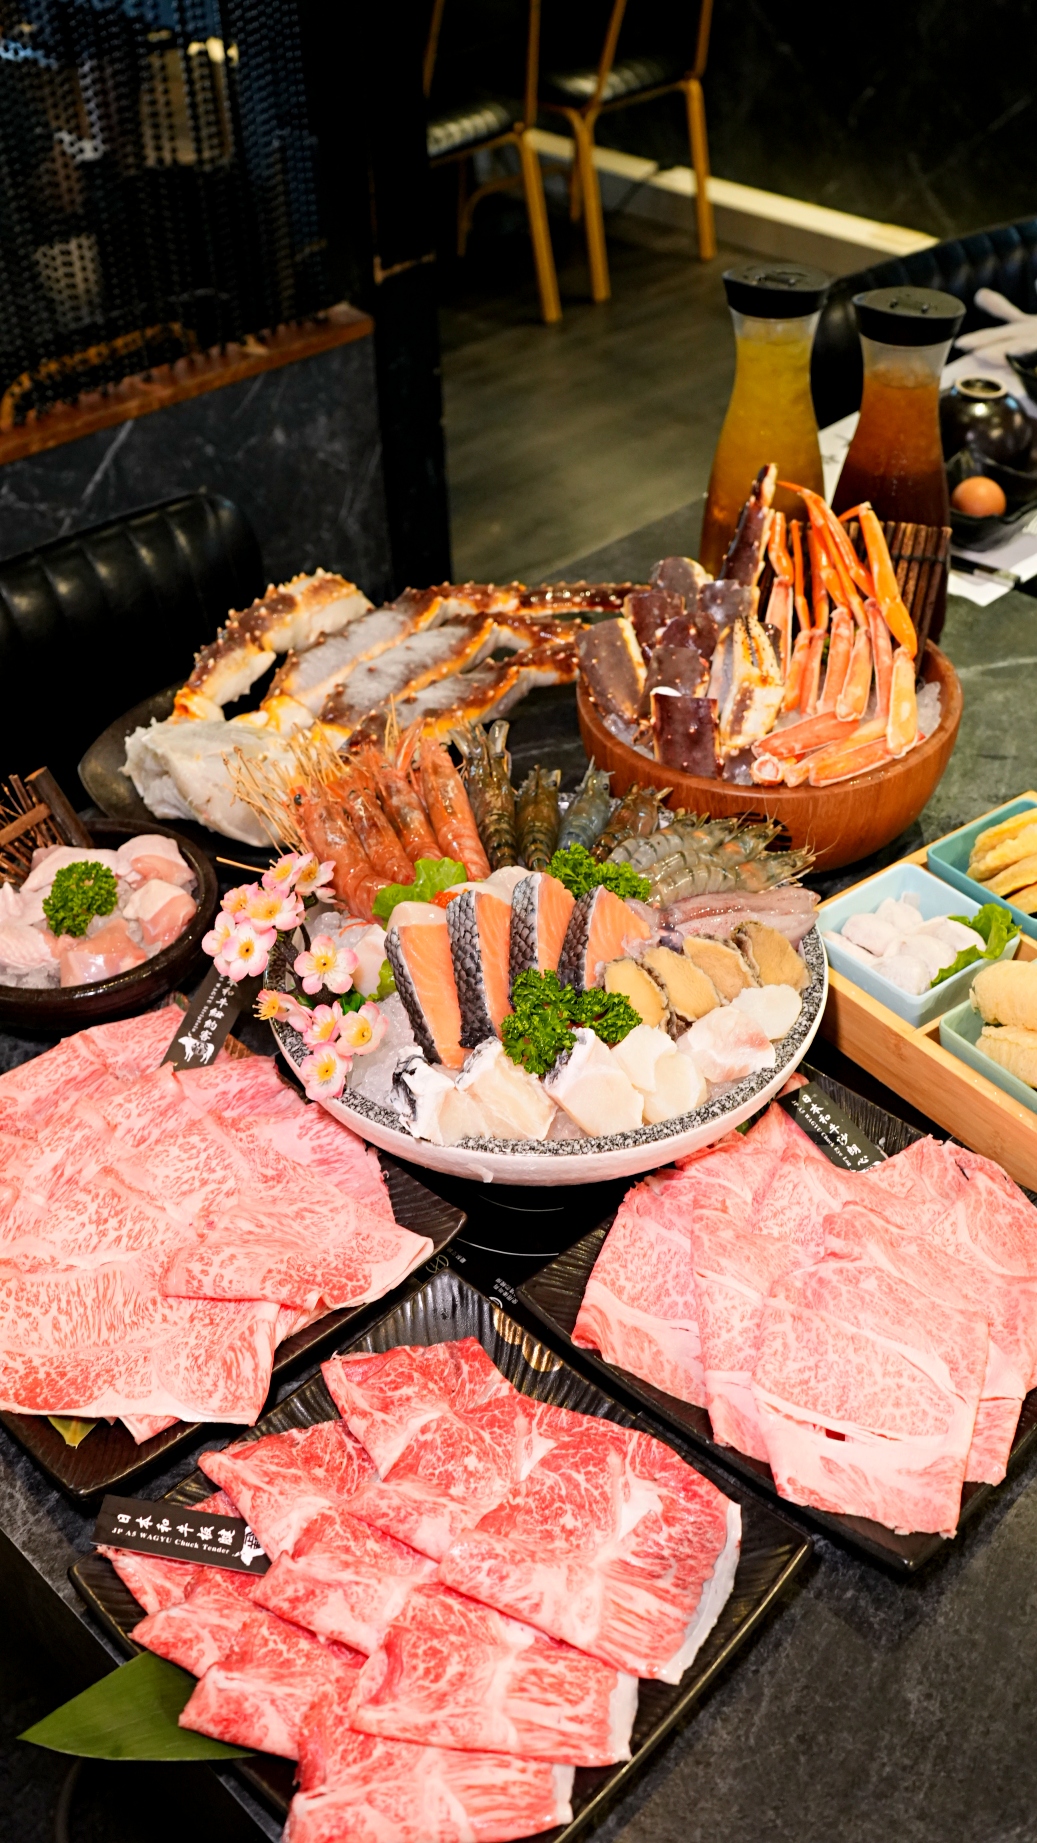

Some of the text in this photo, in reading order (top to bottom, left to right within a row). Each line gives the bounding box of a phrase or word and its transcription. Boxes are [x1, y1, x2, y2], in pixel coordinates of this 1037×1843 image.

[805, 1114, 822, 1132] WAGYU
[821, 1133, 835, 1147] Chuck
[834, 1147, 843, 1156] Eye
[111, 1527, 230, 1555] JP A5 WAGYU Chuck Tender
[116, 1513, 236, 1546] 日本和牛板腱
